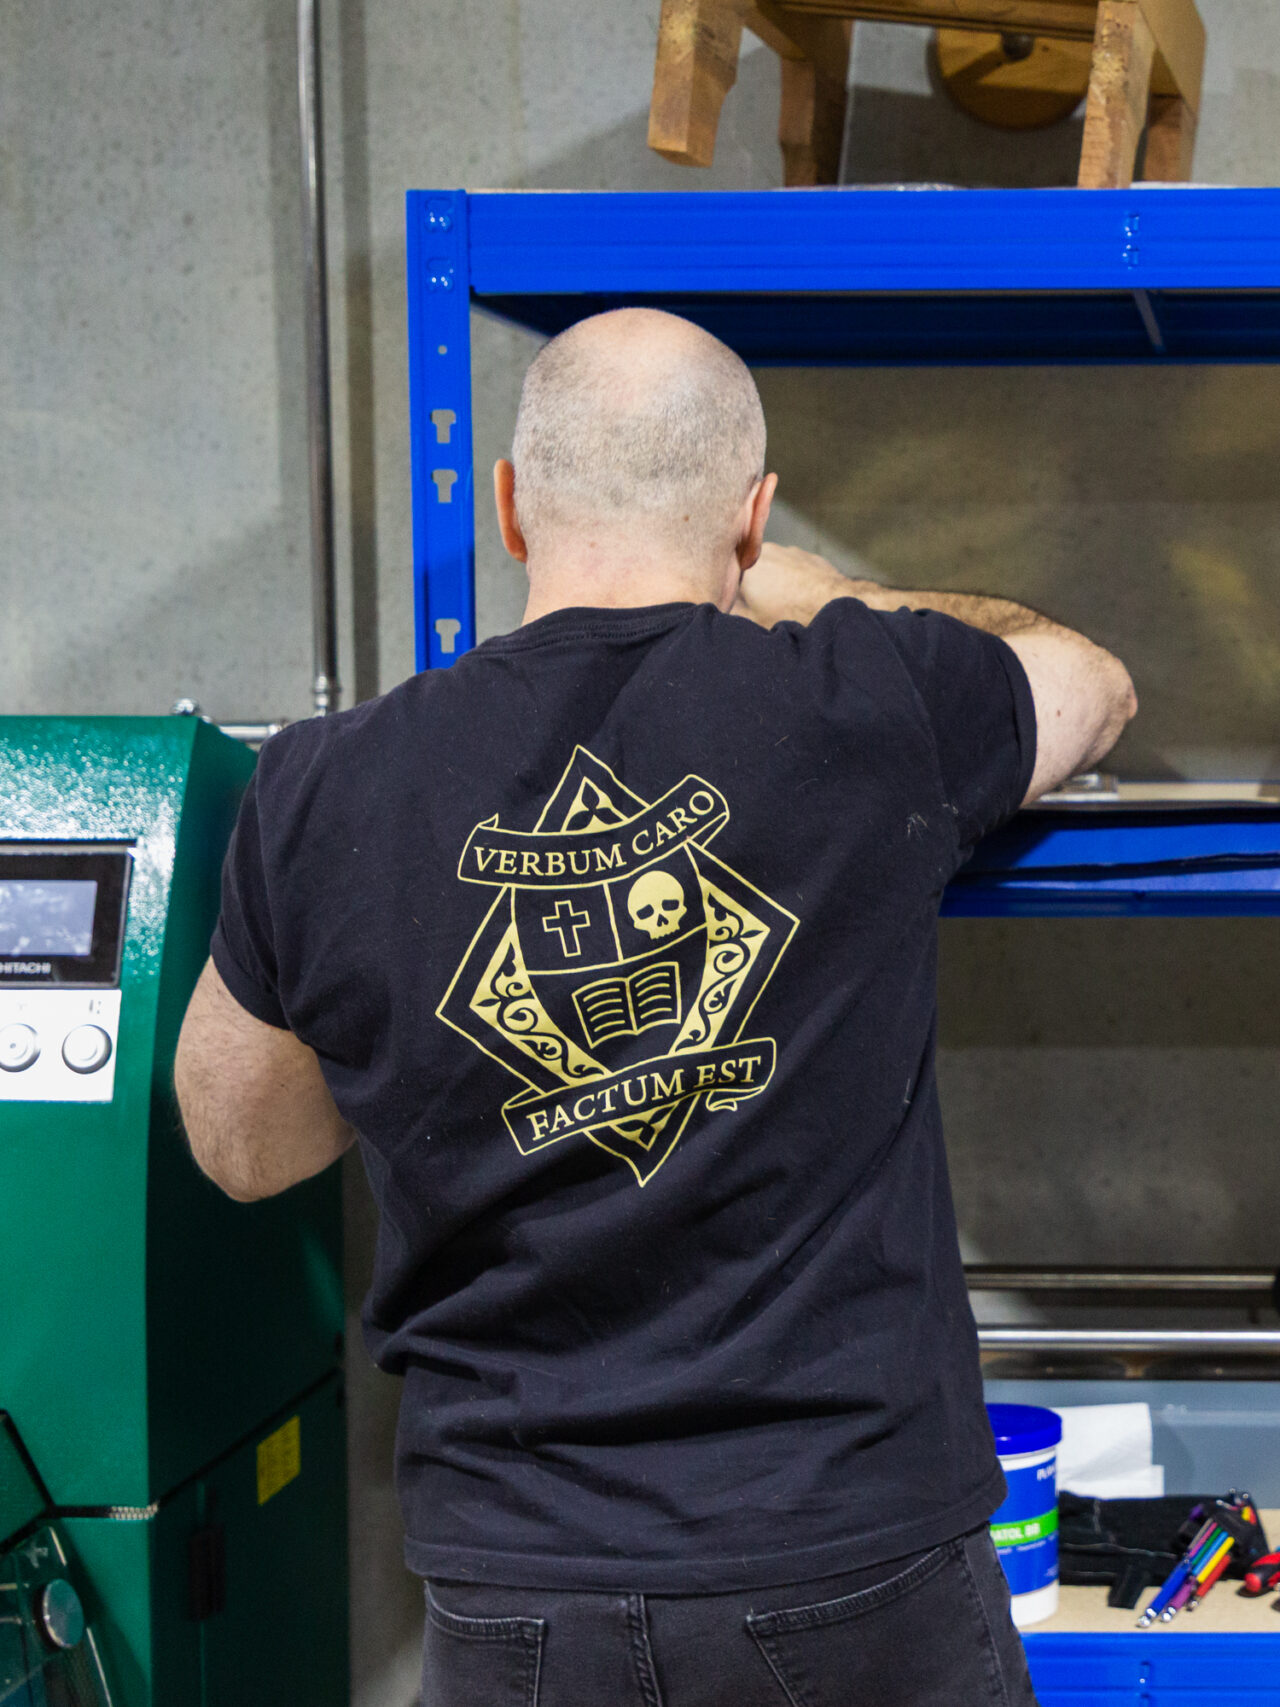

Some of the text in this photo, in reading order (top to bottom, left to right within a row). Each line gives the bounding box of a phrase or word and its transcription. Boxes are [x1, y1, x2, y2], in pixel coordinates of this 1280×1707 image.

[473, 790, 715, 877] VERBUM CARO
[0, 961, 51, 975] HITACHI
[526, 1056, 762, 1142] FACTUM EST
